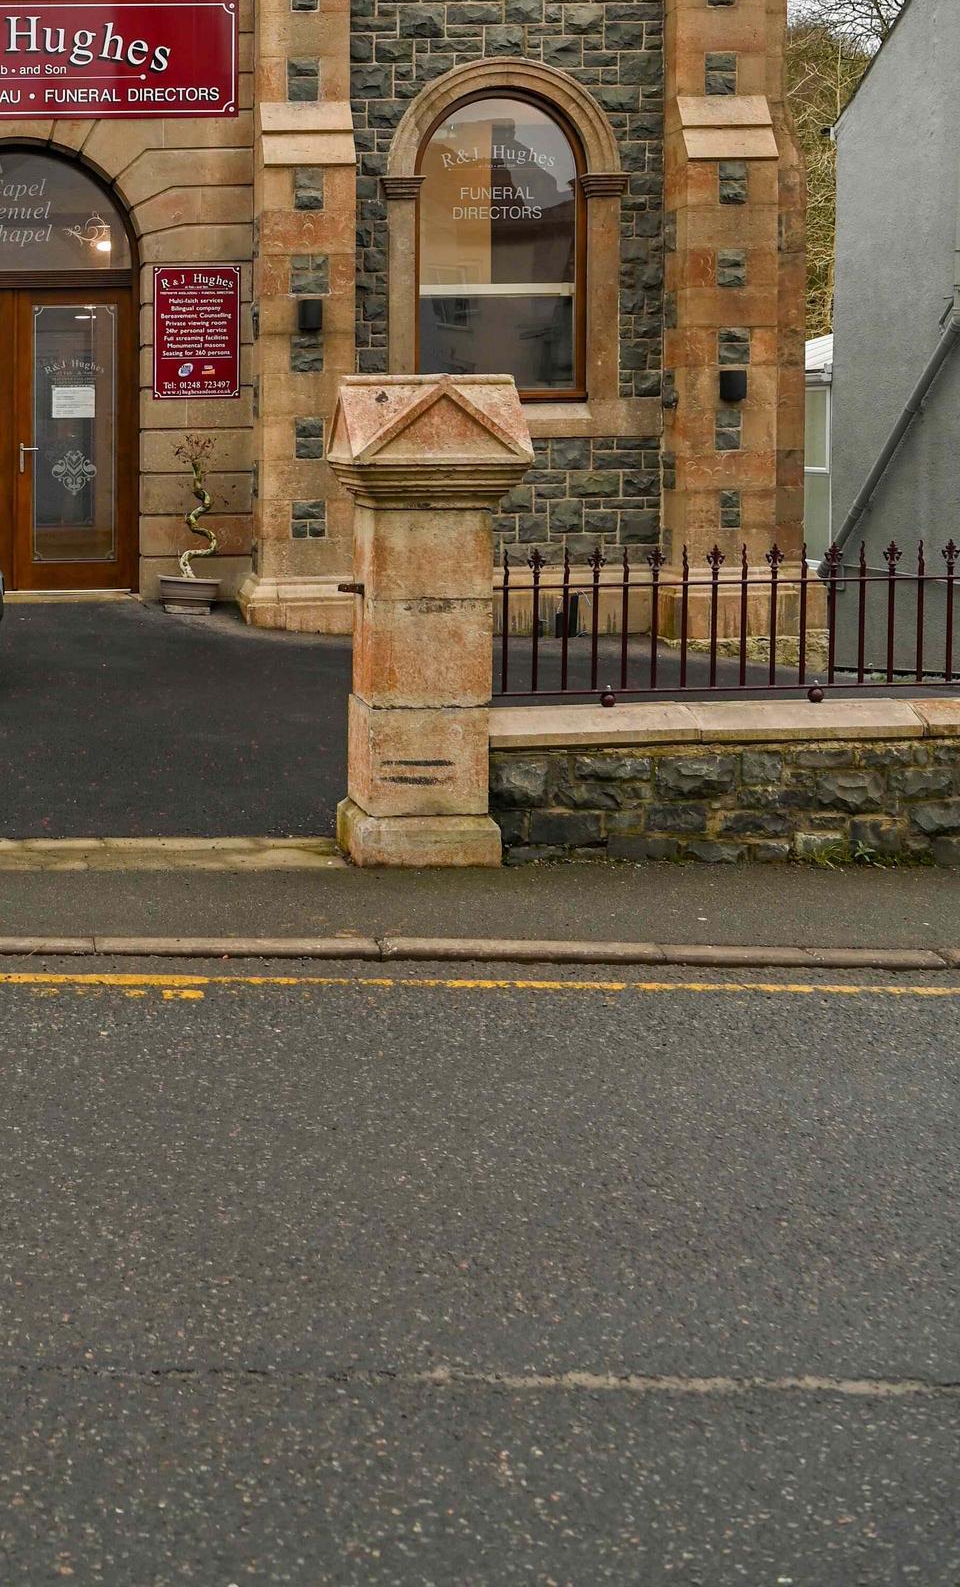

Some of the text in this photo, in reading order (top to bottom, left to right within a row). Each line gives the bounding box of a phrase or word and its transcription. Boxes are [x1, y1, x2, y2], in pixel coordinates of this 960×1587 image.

[6, 16, 171, 71] Hughes
[20, 65, 40, 74] and
[45, 65, 67, 74] Son
[45, 89, 121, 102] FUNERAL
[128, 87, 219, 102] DIRECTORS
[492, 145, 556, 166] Hughes
[460, 187, 534, 199] FUNERAL
[453, 206, 542, 219] DIRECTORS
[161, 279, 170, 289] R
[181, 275, 185, 284] J
[194, 274, 233, 288] Hughes
